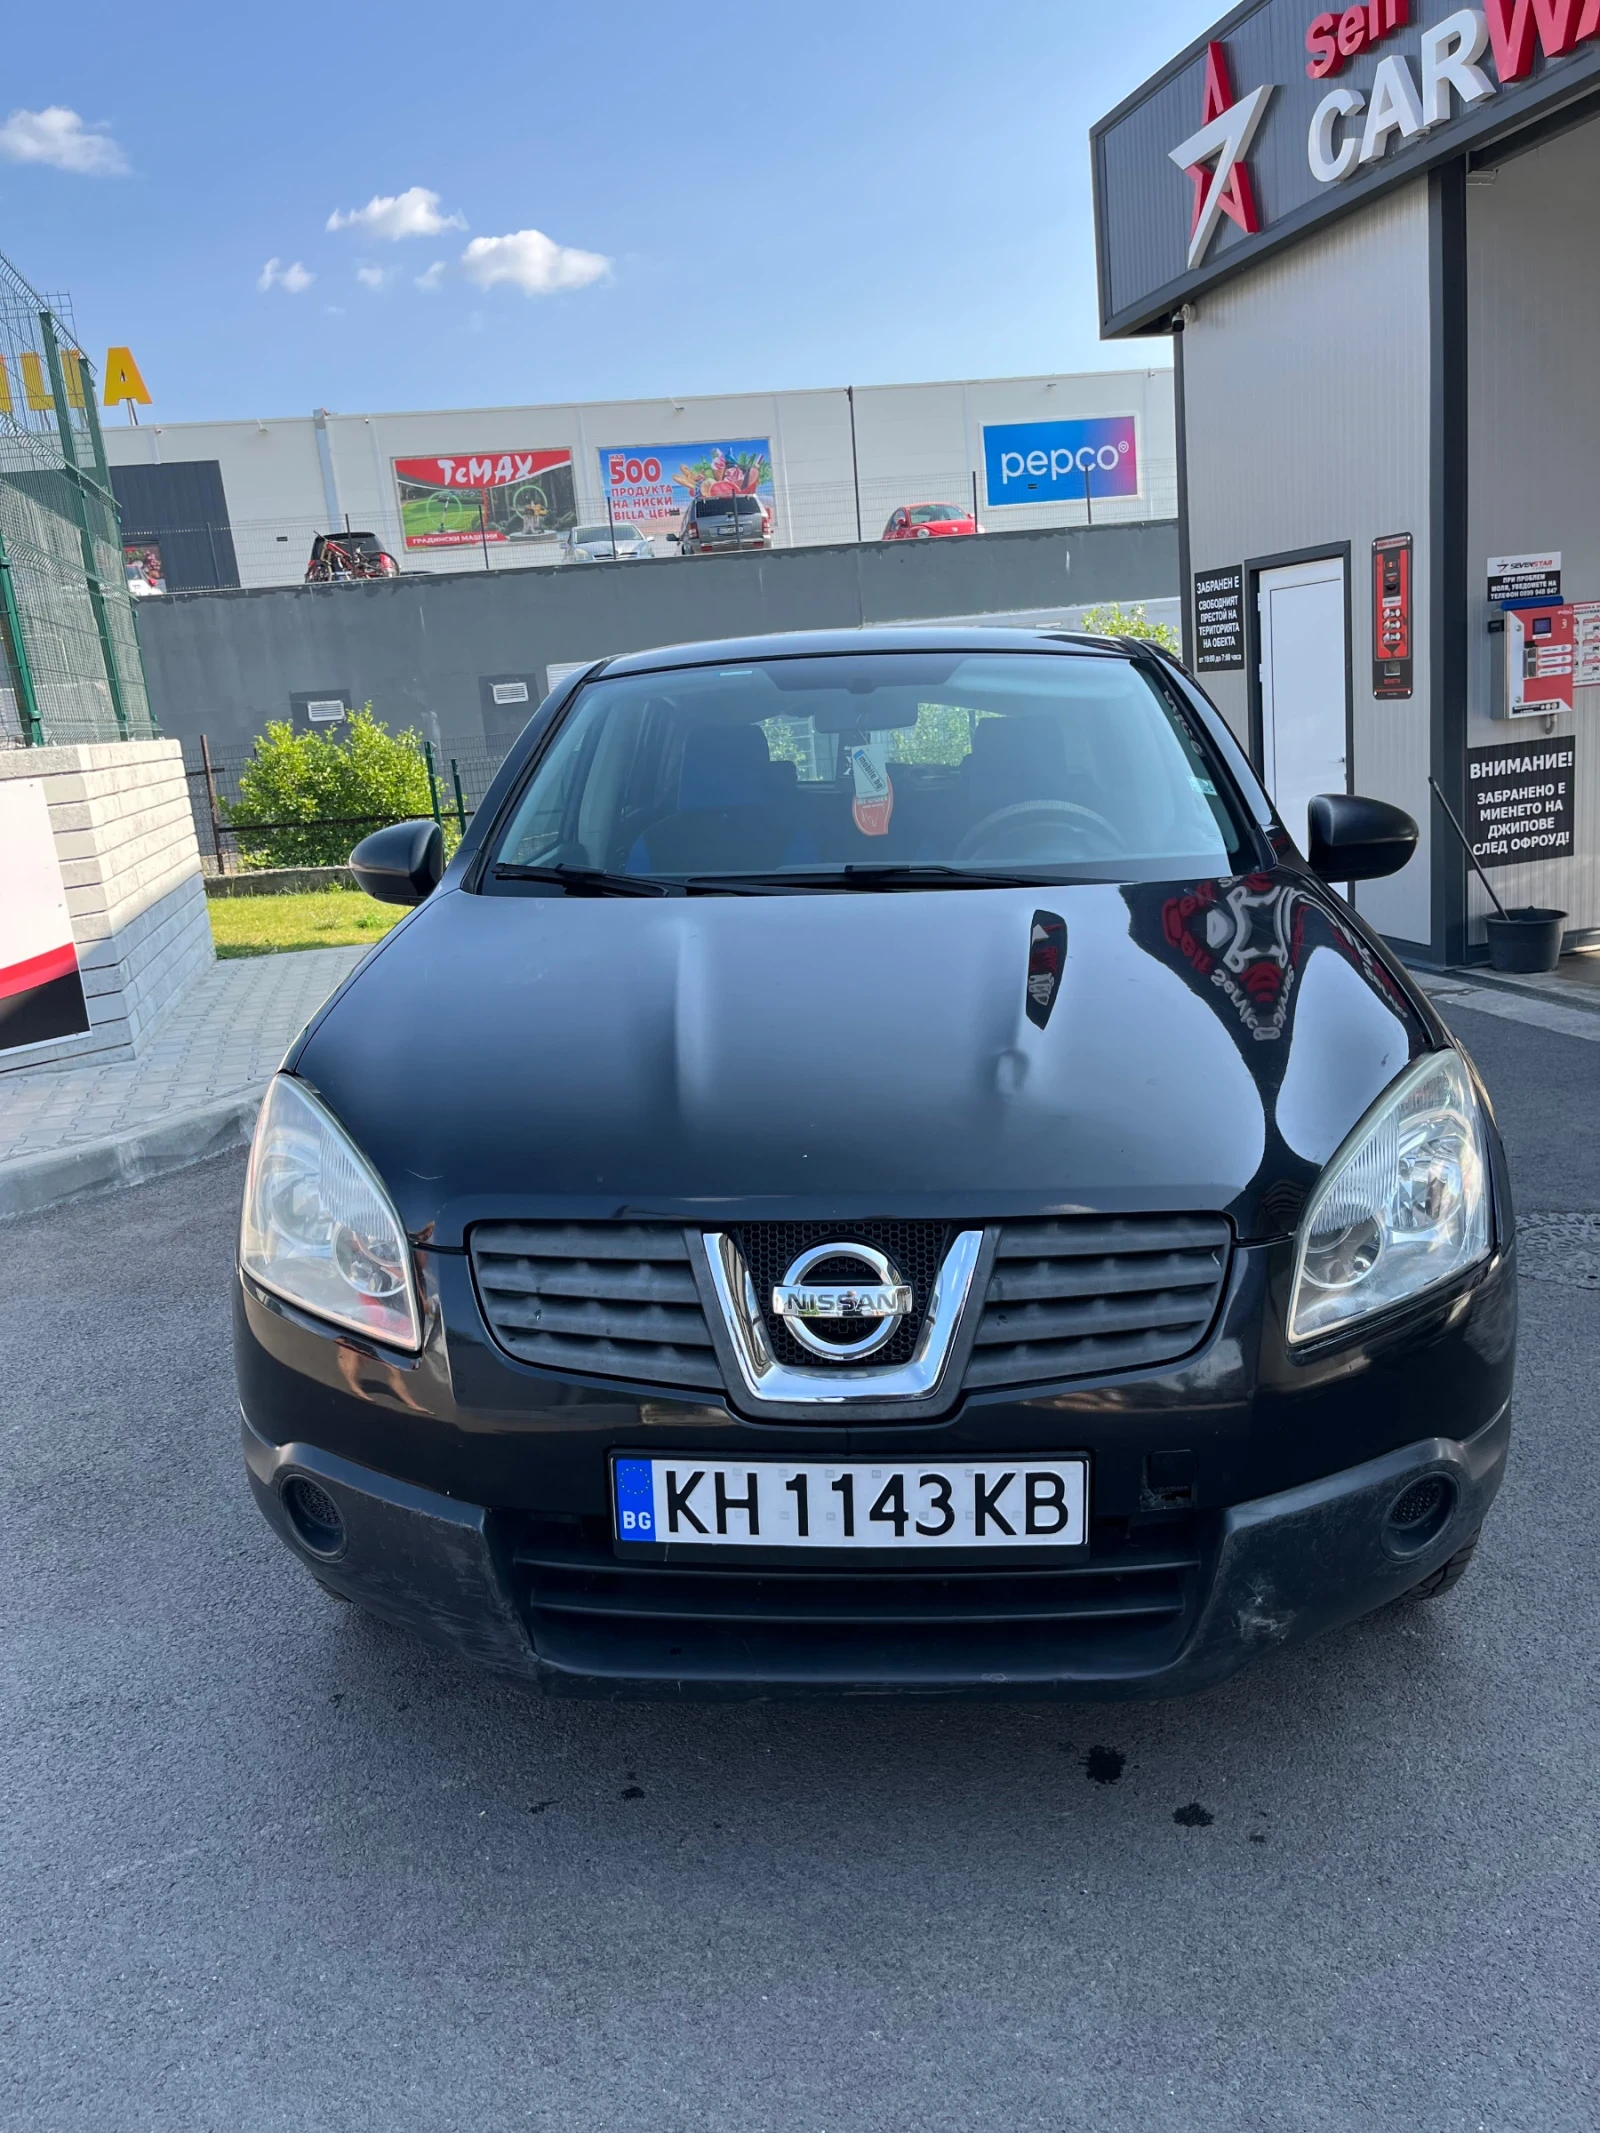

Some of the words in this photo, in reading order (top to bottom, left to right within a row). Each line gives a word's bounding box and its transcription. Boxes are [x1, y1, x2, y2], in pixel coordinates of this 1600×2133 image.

[1305, 0, 1410, 80] Sel
[1308, 0, 1600, 182] CARW
[437, 455, 532, 485] TeMAX
[610, 458, 661, 485] 500
[1001, 445, 1119, 484] pepco
[611, 485, 672, 497] ПРОДУКТА
[612, 499, 628, 508] НА
[633, 496, 672, 508] НИСКИ
[614, 510, 644, 520] BILLA
[1197, 577, 1233, 594] ЗАБРАНЕН
[1234, 576, 1240, 588] Е
[1512, 581, 1547, 590] УВЕДОМЕТЕ
[1517, 574, 1546, 582] ПРОБЛЕМ
[1490, 591, 1519, 600] ТЕЛЕФОН
[1200, 609, 1228, 623] ПРЕСТОЙ
[1228, 609, 1237, 619] НА
[1198, 622, 1240, 636] ТЕРИТОРИЯТА
[1203, 638, 1212, 648] НА
[1212, 636, 1236, 648] ОБЕКТА
[858, 756, 883, 790] mobile.bg
[1470, 751, 1573, 779] ВНИМАНИЕ!
[1477, 784, 1555, 805] ЗАБРАНЕНО
[1558, 782, 1566, 794] Е
[1480, 802, 1542, 821] МИЕНЕТО
[1545, 799, 1564, 813] НА
[1487, 817, 1555, 840] ДЖИПОВЕ
[1472, 840, 1508, 855] СЛЕД
[1510, 831, 1570, 850] ОФРОУД!
[787, 1293, 898, 1311] NISSAN
[622, 1510, 652, 1530] BG
